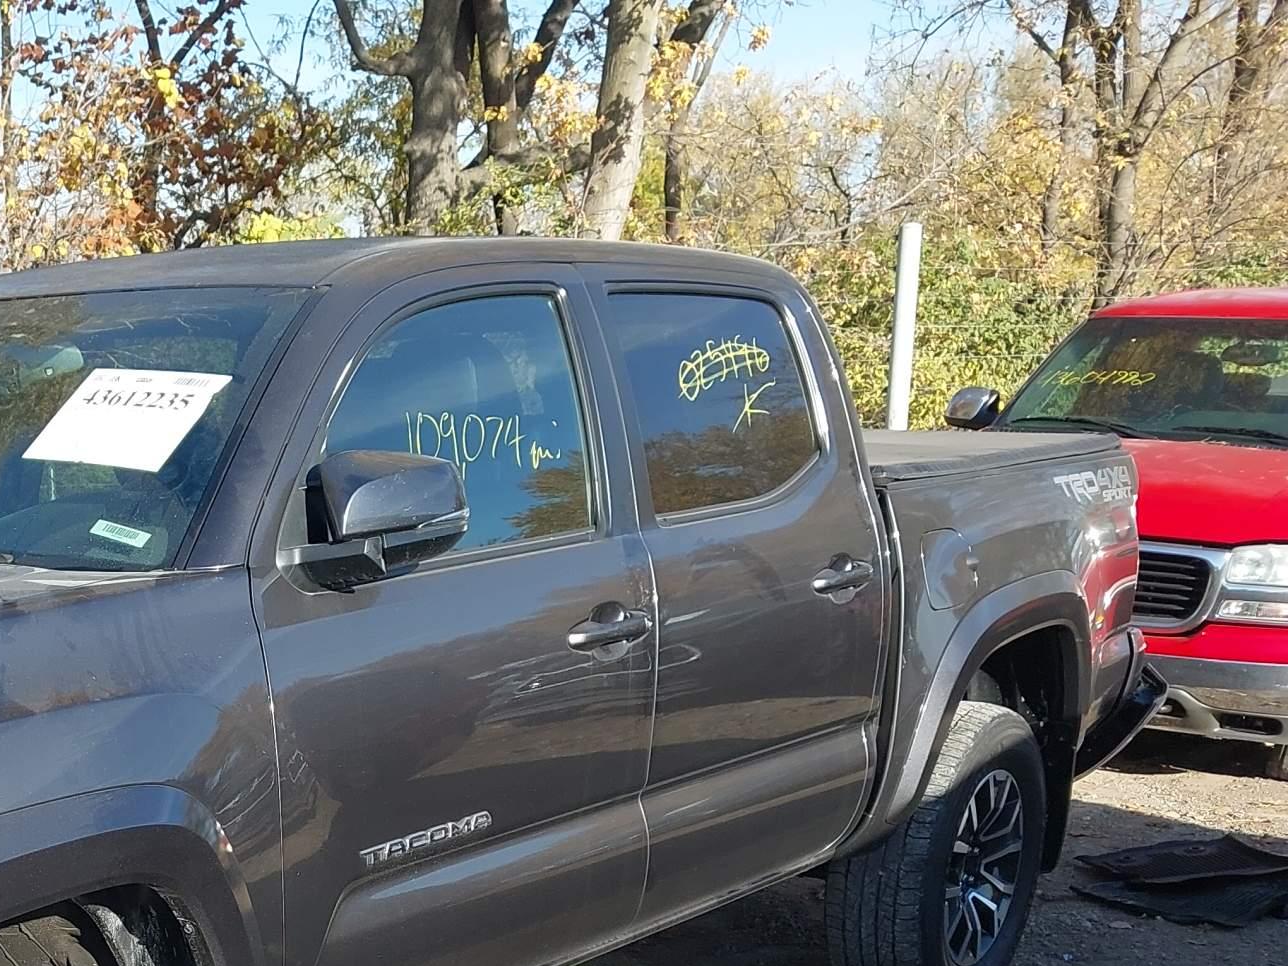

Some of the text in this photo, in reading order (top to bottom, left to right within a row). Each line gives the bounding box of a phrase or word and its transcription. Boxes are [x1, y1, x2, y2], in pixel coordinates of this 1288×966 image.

[83, 389, 195, 410] 43612235
[1103, 486, 1131, 502] SPORT
[359, 811, 492, 865] TACOMA
